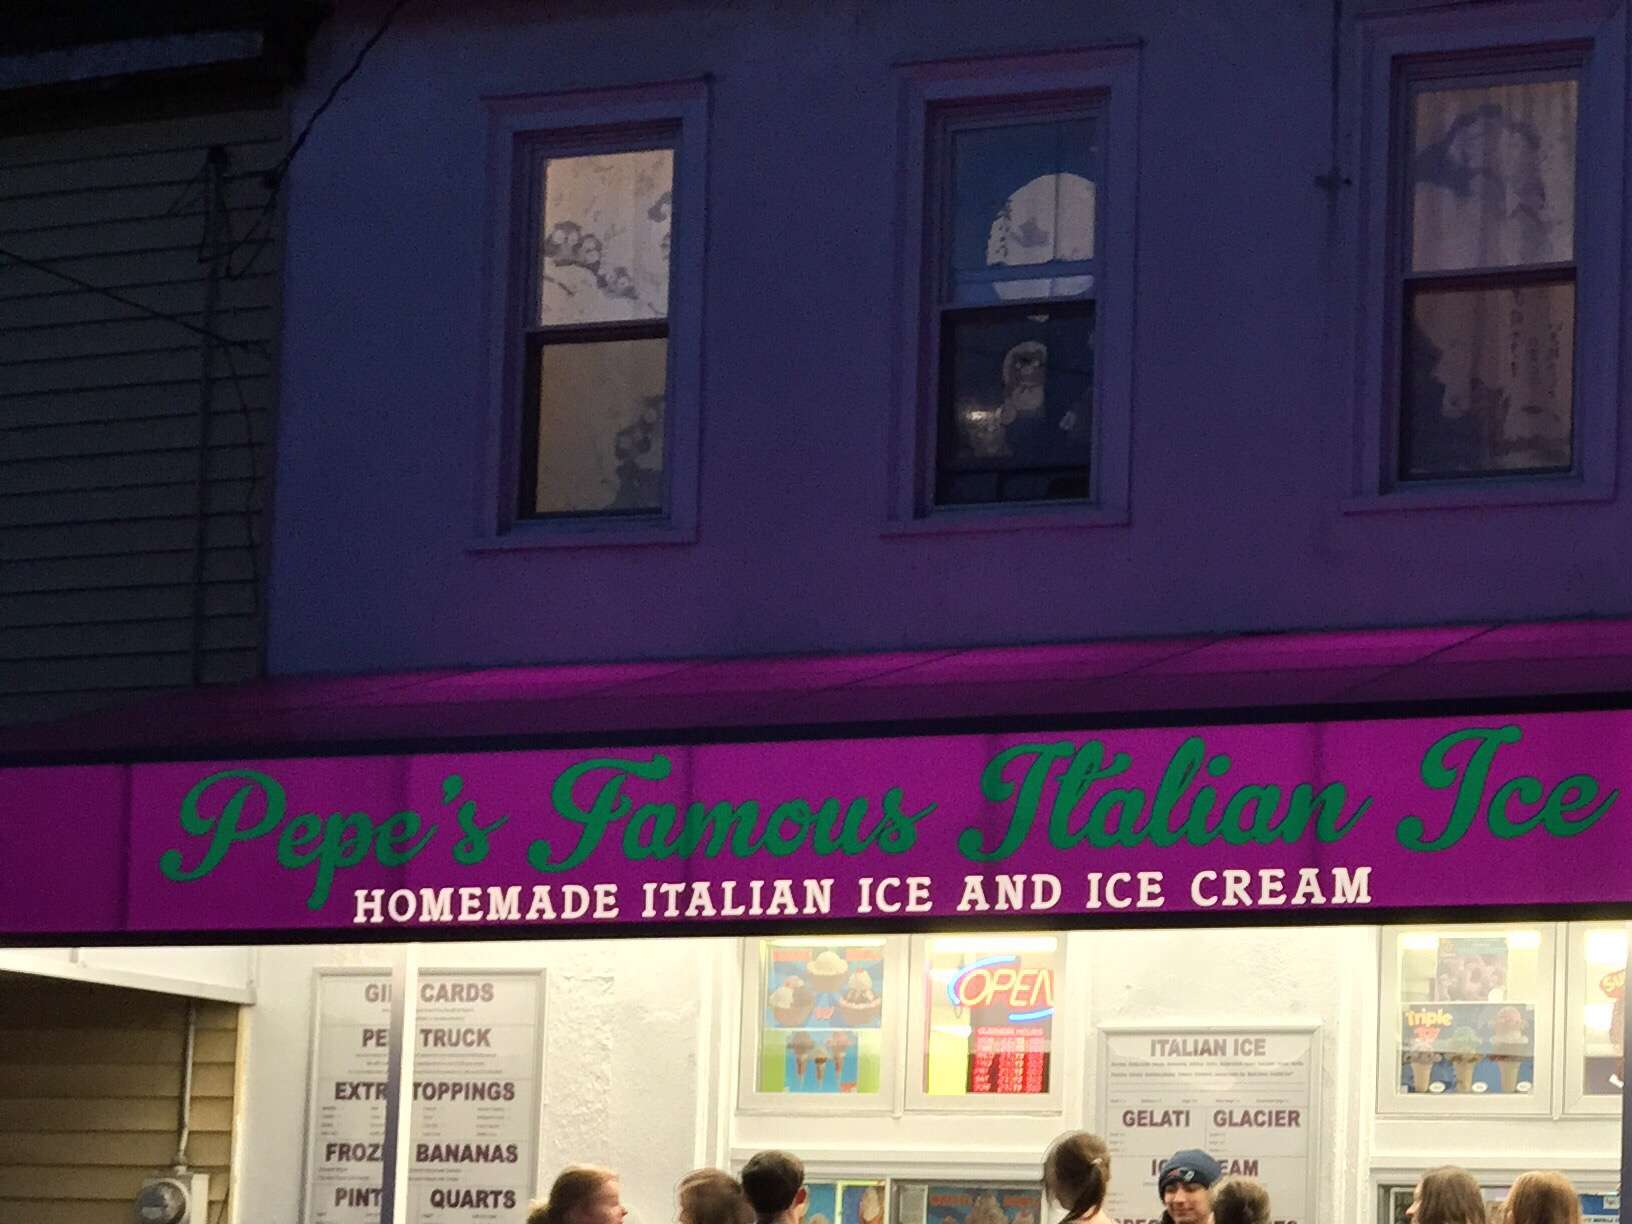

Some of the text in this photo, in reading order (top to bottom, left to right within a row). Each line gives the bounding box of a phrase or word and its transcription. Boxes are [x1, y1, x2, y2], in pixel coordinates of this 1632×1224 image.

[159, 725, 1619, 910] Pepe's Famous Italian Ice
[353, 866, 1373, 924] HOMEMADE ITALIAN ICE AND ICE CREAM
[364, 983, 495, 1003] GI CARDS
[959, 968, 1055, 1007] OPEN
[1406, 1008, 1453, 1027] Triple
[420, 1028, 492, 1048] TRUCK
[1150, 1038, 1266, 1057] ITALIAN ICE
[335, 1081, 515, 1101] EXTR TOPPINGS
[1122, 1110, 1301, 1128] GELATI GLACIER
[325, 1143, 518, 1163] FROZ BANANAS
[335, 1188, 517, 1209] PINT QUARTS
